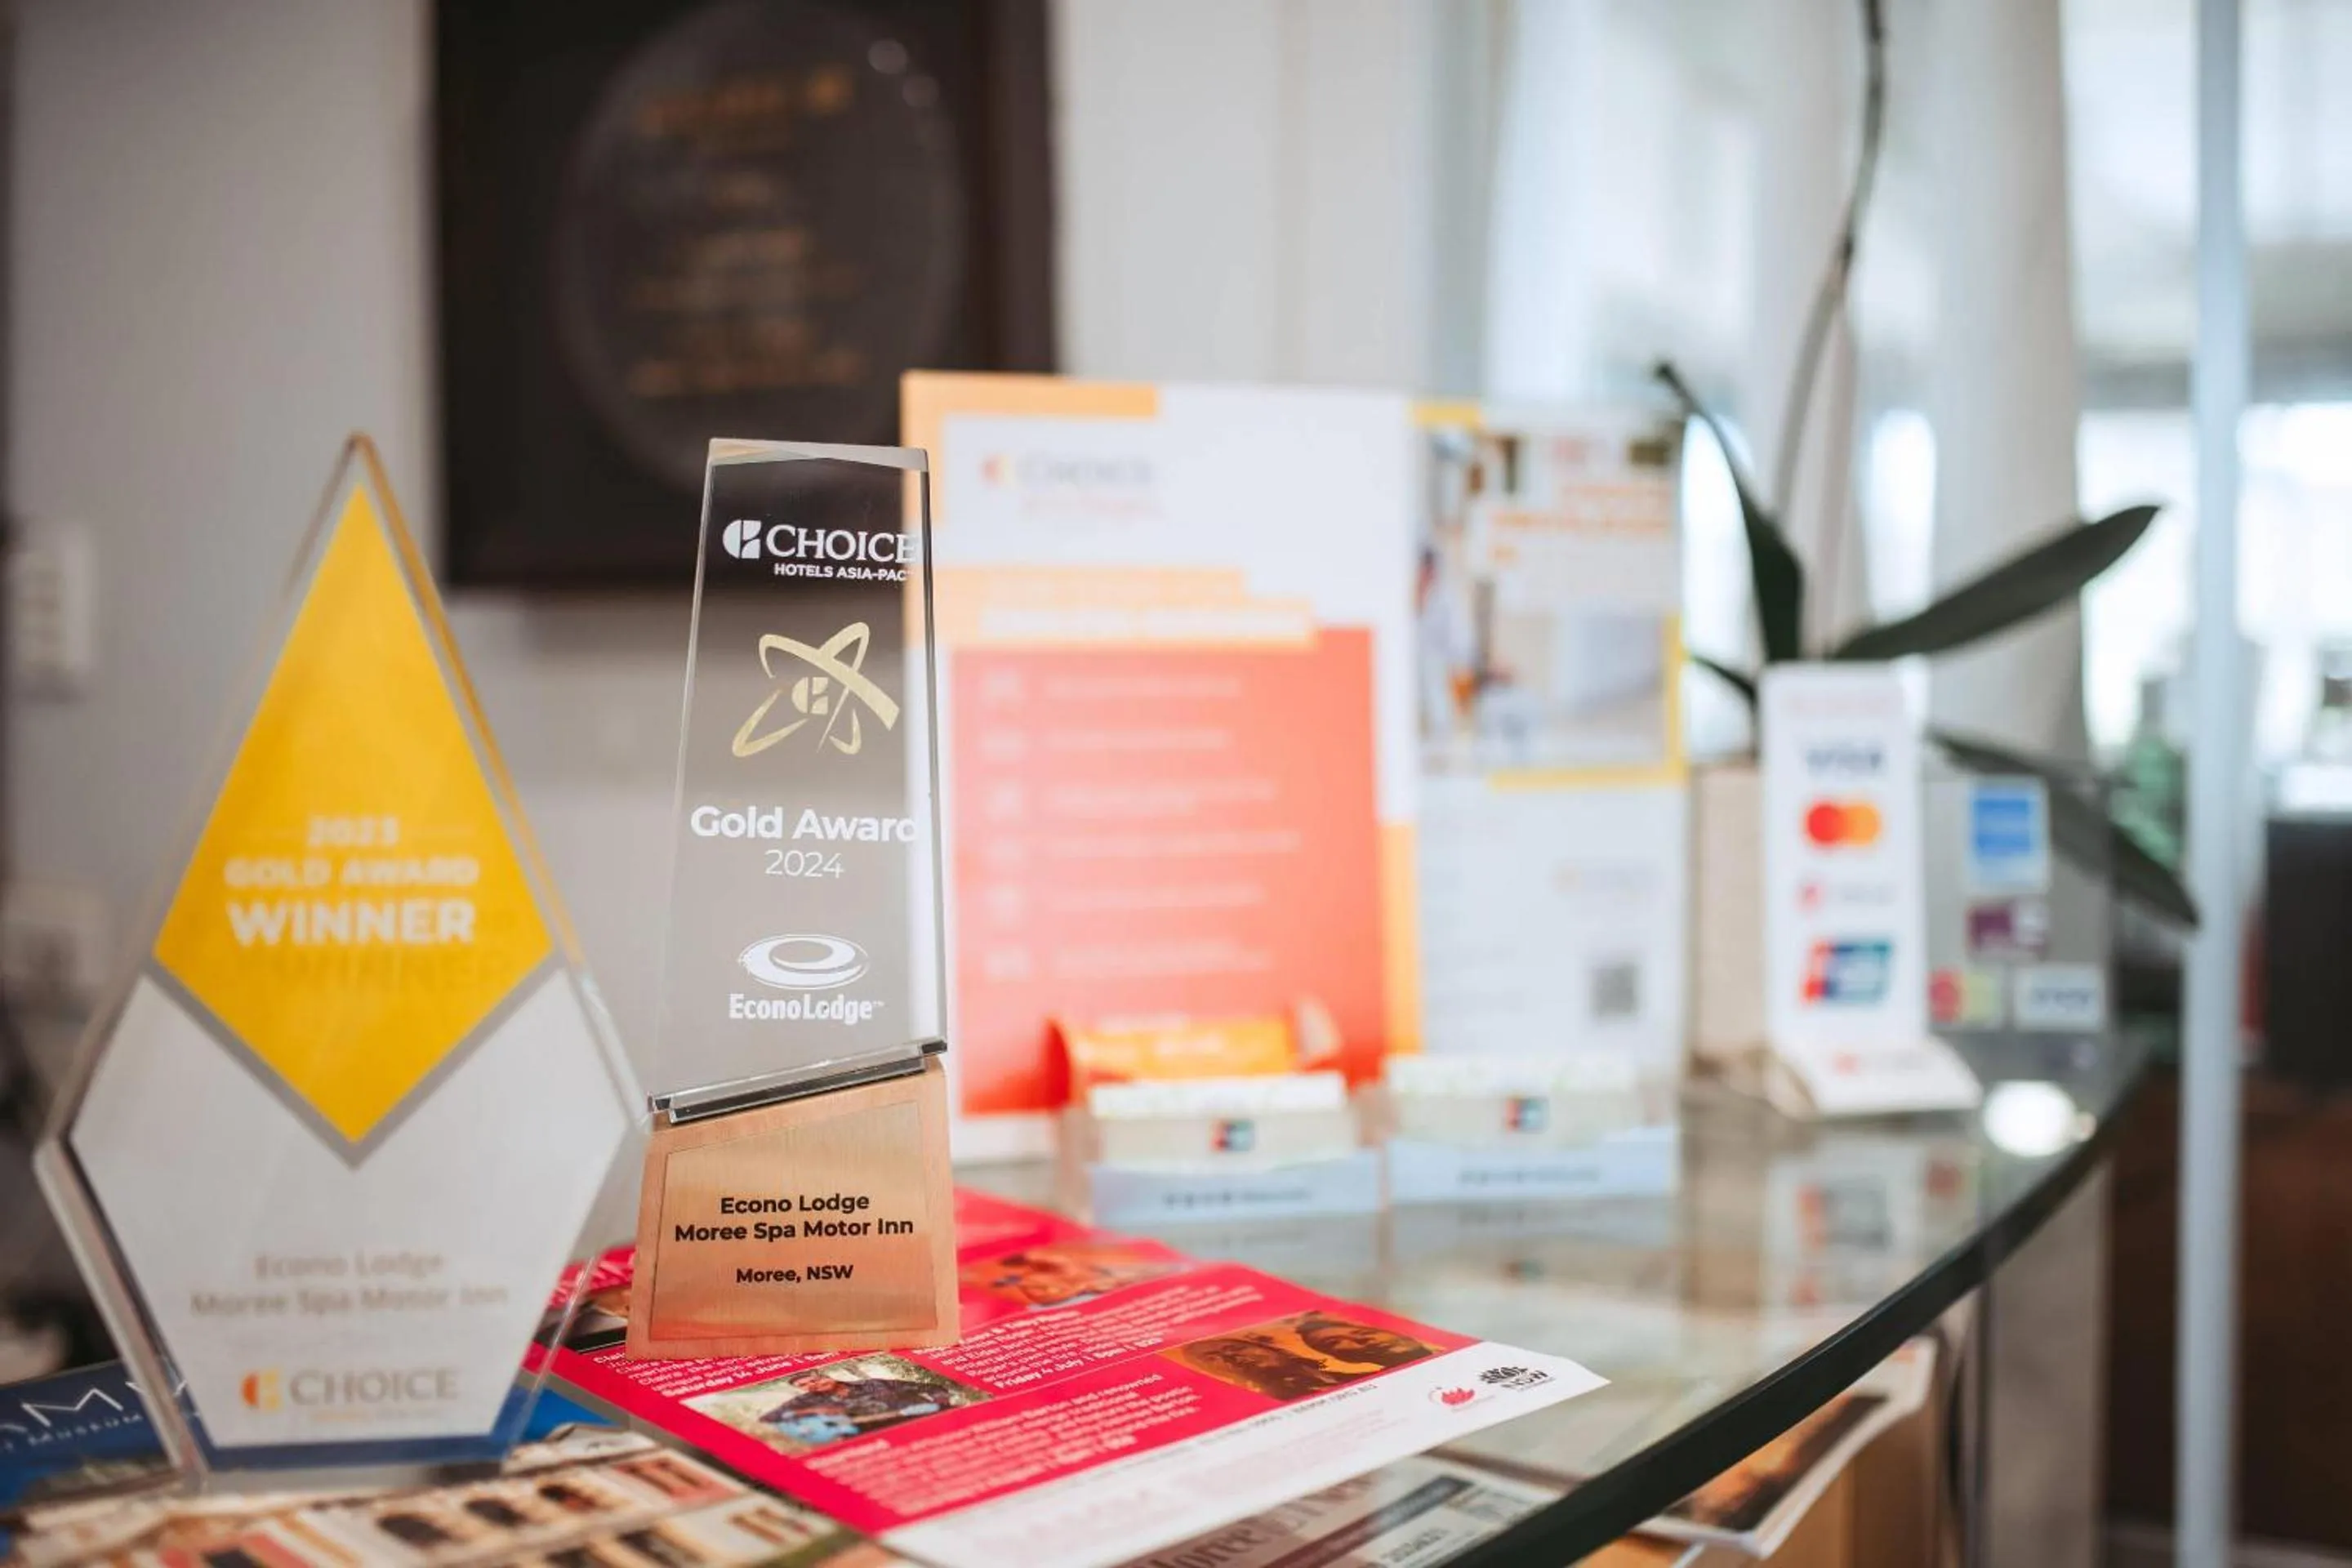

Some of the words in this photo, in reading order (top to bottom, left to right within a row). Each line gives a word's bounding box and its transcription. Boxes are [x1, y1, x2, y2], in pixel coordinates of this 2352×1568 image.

[766, 523, 916, 564] CHOICE
[774, 563, 833, 578] HOTELS
[690, 805, 782, 839] Gold
[792, 808, 918, 842] Award
[223, 858, 331, 888] GOLD
[340, 857, 480, 887] AWARD
[764, 849, 845, 879] 2024
[226, 898, 476, 947] WINNER
[720, 1196, 792, 1215] Econo
[799, 1193, 870, 1214] Lodge
[674, 1223, 747, 1242] Moree
[753, 1223, 796, 1242] Spa
[804, 1219, 871, 1238] Motor
[878, 1218, 914, 1235] Inn
[736, 1266, 802, 1284] Moree,
[807, 1264, 854, 1281] NSW
[289, 1367, 460, 1405] CHOICE
